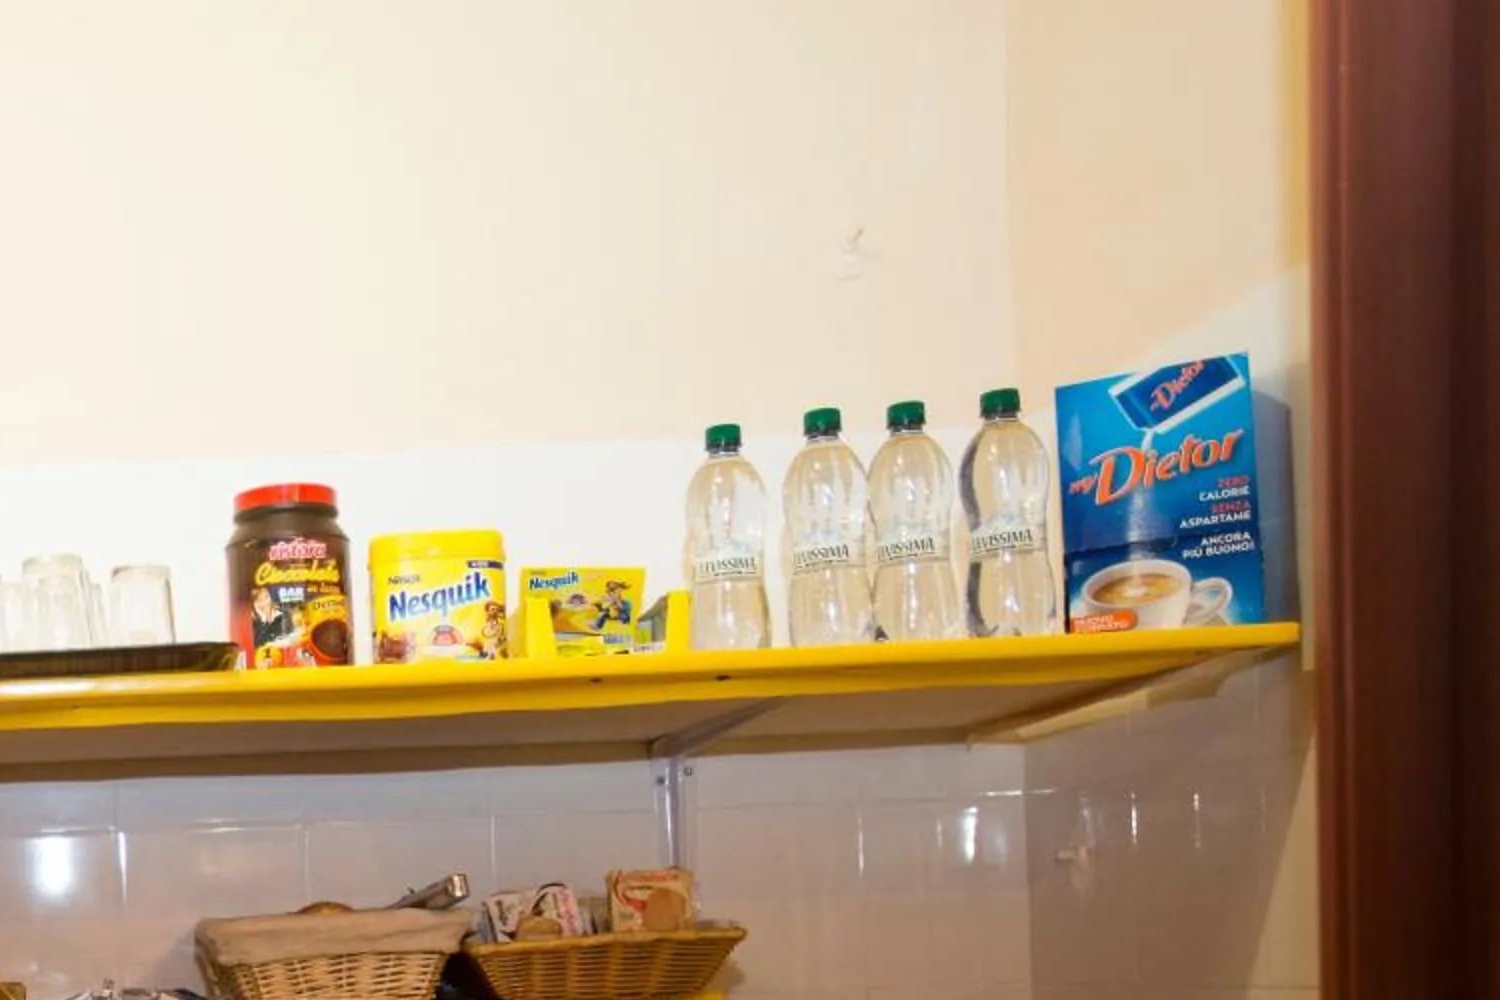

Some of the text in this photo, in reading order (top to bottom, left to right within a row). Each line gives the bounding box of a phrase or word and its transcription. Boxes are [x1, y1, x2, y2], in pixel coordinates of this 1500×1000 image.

[1088, 427, 1245, 506] Dietor
[1199, 484, 1251, 502] CALORIE
[1179, 509, 1252, 529] ASPARTAME
[1201, 531, 1252, 547] ANCORA
[529, 571, 580, 590] Nesquik
[388, 571, 490, 622] Nesquik
